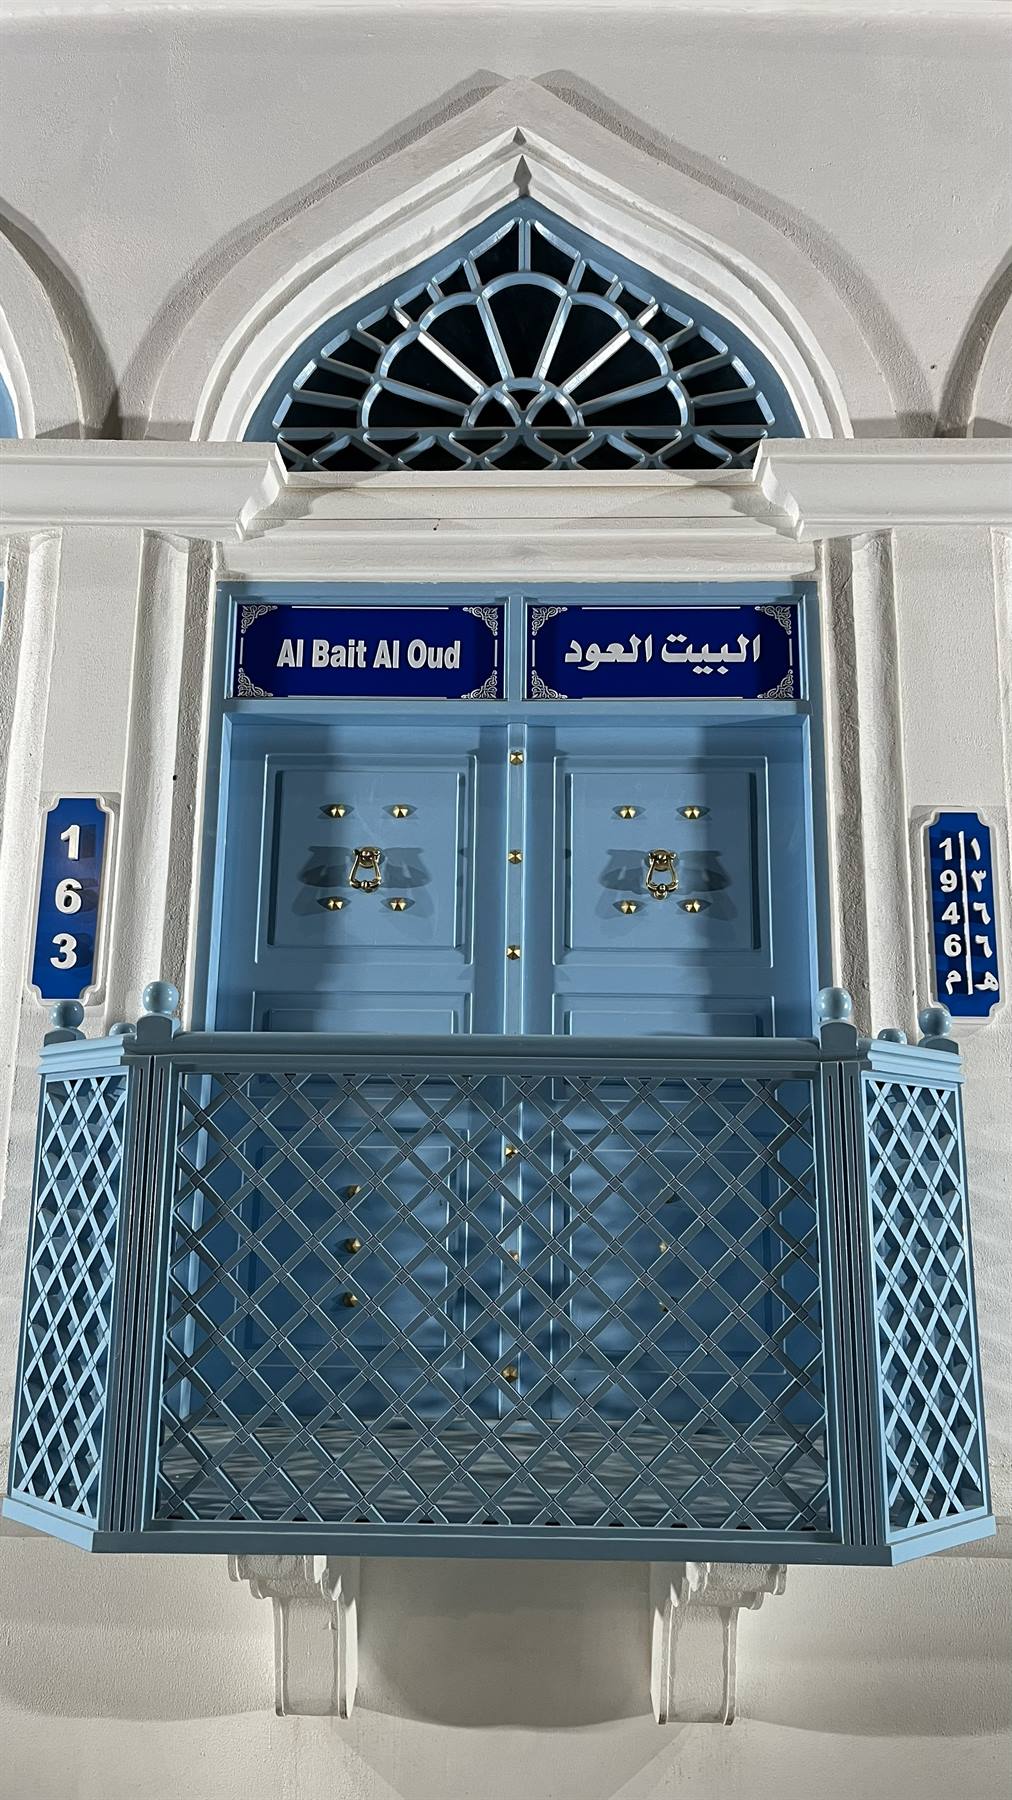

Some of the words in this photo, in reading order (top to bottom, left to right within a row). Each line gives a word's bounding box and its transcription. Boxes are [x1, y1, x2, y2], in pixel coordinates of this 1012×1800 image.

[276, 638, 304, 668] Al
[311, 639, 367, 668] Bait
[372, 639, 400, 669] Al
[407, 639, 461, 670] Oud
[564, 633, 653, 671] العود
[661, 633, 761, 675] البيت
